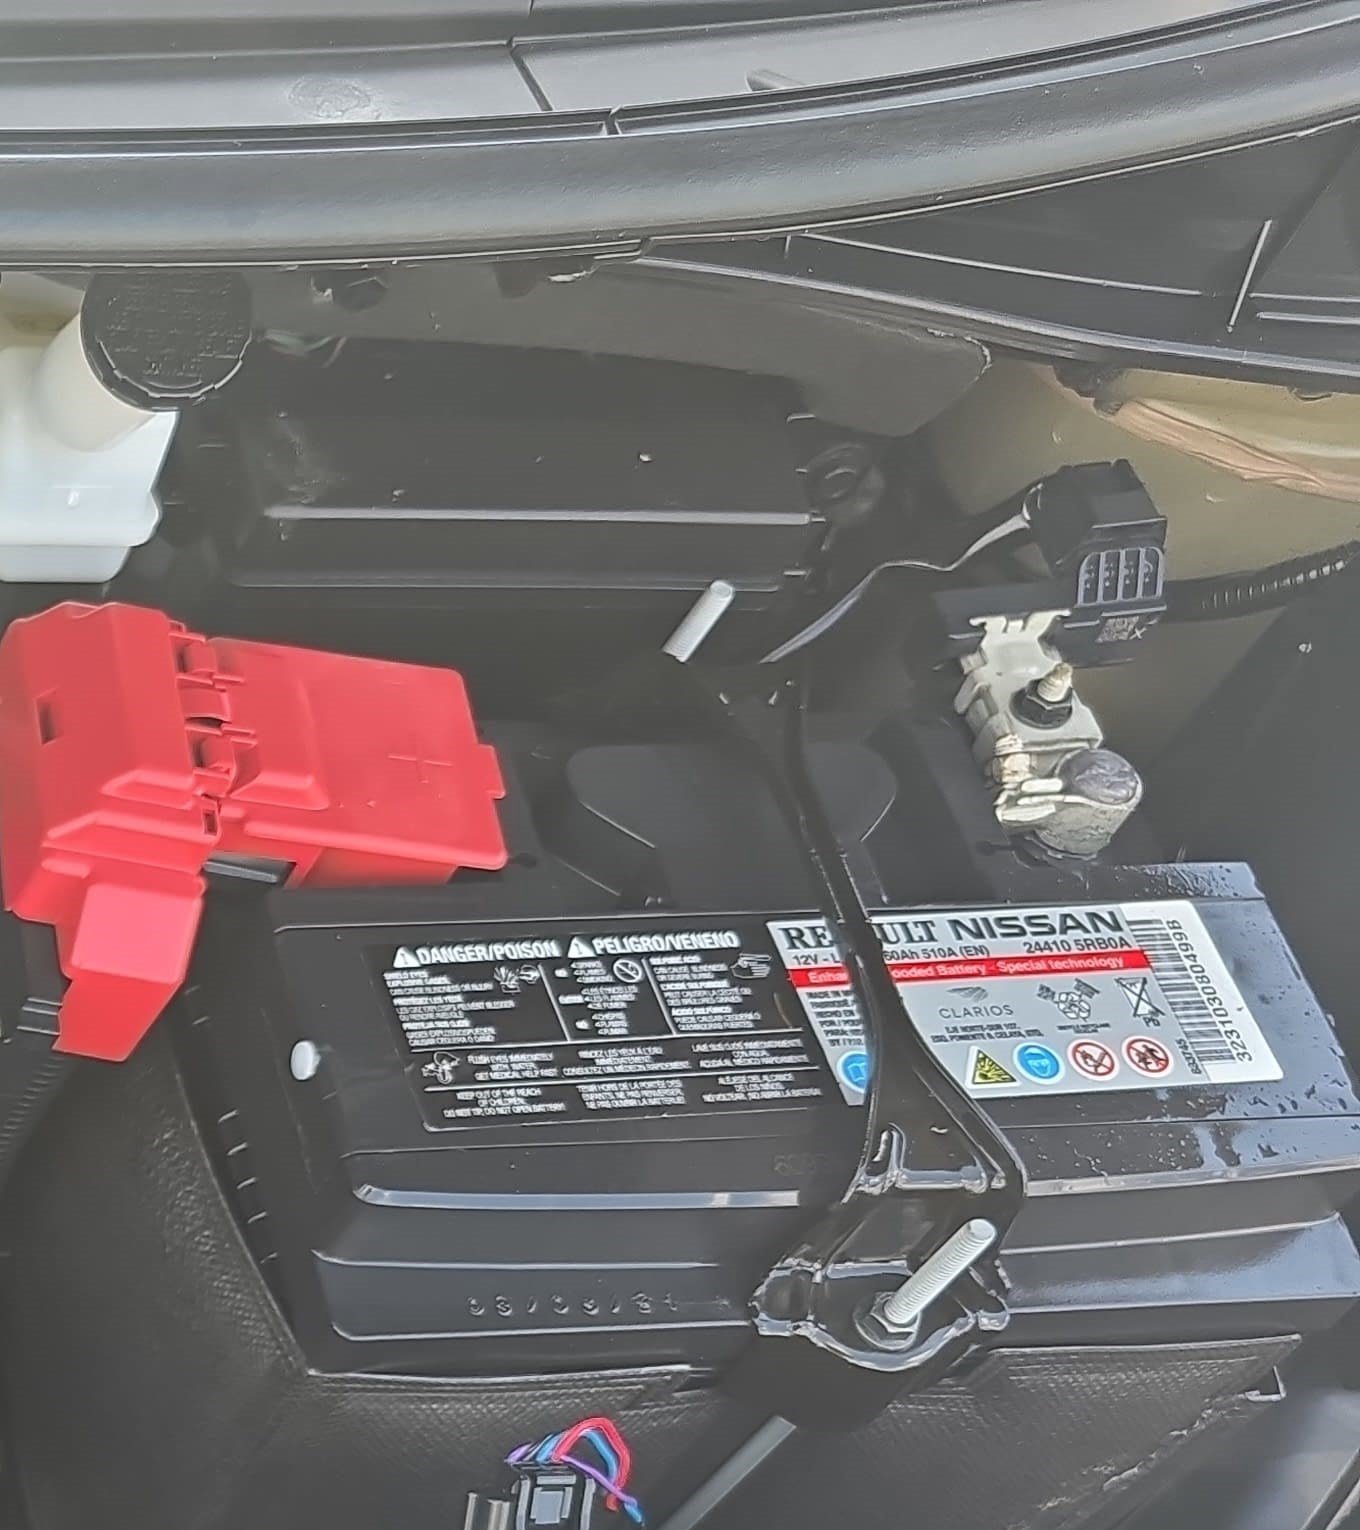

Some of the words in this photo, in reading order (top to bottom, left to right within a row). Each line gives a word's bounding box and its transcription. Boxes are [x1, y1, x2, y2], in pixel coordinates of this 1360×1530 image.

[947, 911, 1123, 941] NISSAN
[416, 939, 562, 965] DANGER/POISON
[591, 930, 741, 955] PELIGRO/VENENO
[1023, 940, 1071, 954] 24410
[793, 954, 819, 966] 12V
[922, 946, 958, 959] 510A
[960, 944, 990, 959] (EN)
[937, 962, 987, 977] Battery
[997, 958, 1047, 974] Special
[1050, 956, 1124, 971] technology
[1167, 919, 1252, 1063] 323103080499B
[938, 1004, 1014, 1019] CLARIOS
[1142, 1016, 1161, 1028] Pb
